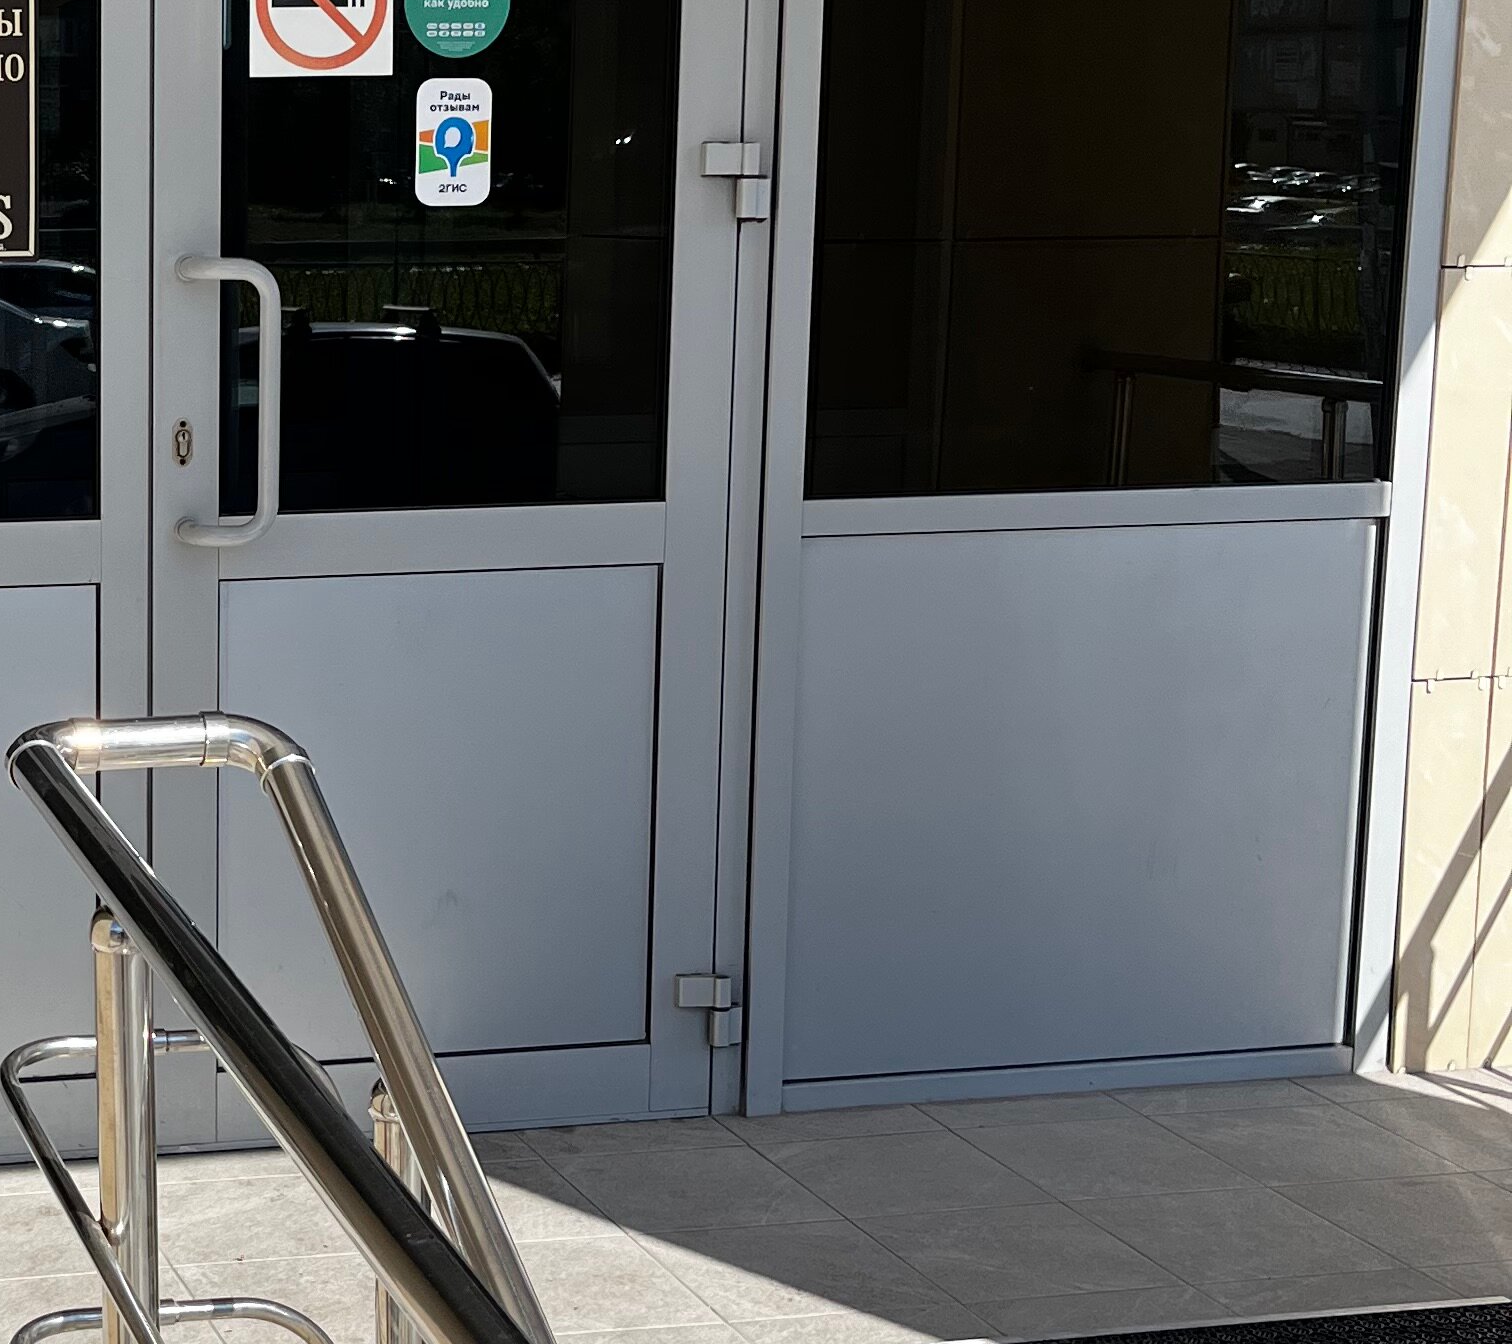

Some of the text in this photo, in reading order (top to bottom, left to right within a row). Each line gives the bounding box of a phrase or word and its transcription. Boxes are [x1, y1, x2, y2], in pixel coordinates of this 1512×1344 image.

[440, 91, 471, 101] Рады
[430, 104, 480, 112] отзывам
[438, 184, 467, 193] 2ГИС
